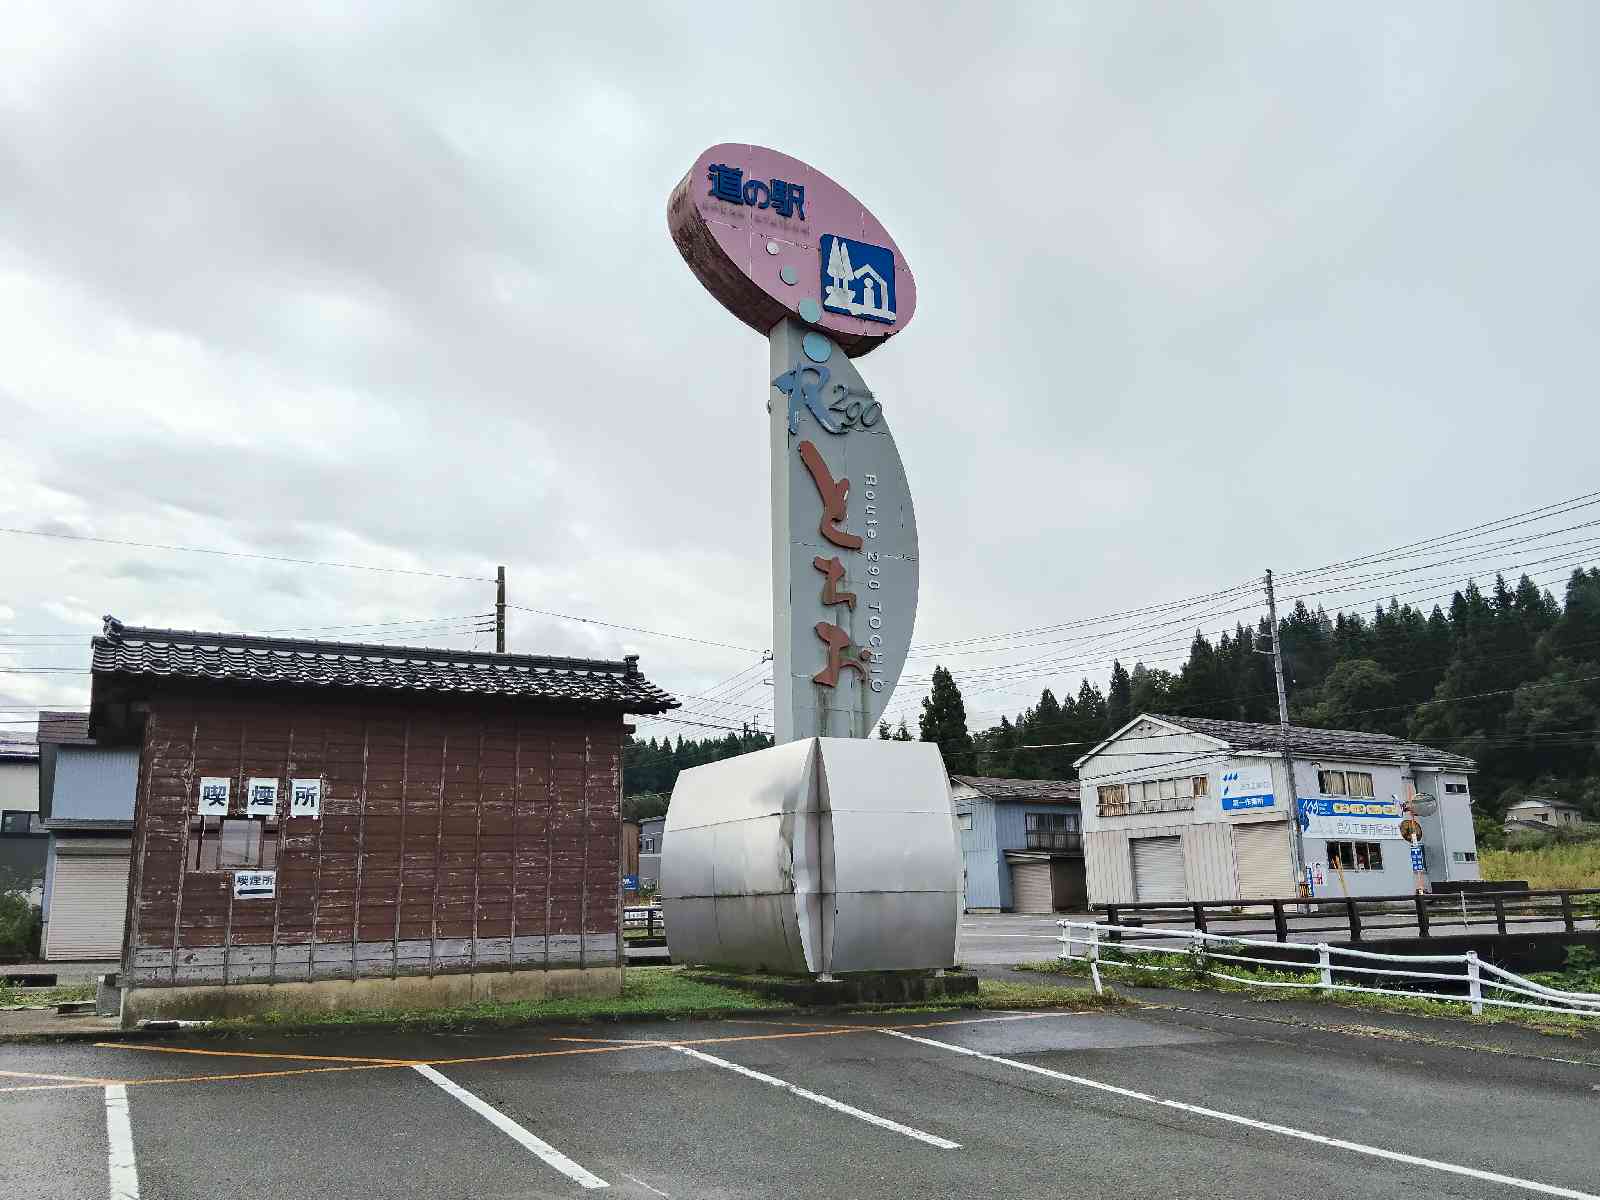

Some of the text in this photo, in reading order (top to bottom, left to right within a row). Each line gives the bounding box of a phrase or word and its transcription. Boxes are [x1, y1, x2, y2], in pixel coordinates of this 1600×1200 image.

[707, 163, 806, 221] 道の駅
[798, 439, 872, 688] とちお
[864, 473, 884, 693] Route 290 TOCHIO
[202, 785, 318, 808] 喫煙所
[237, 874, 273, 887] 喫煙所
